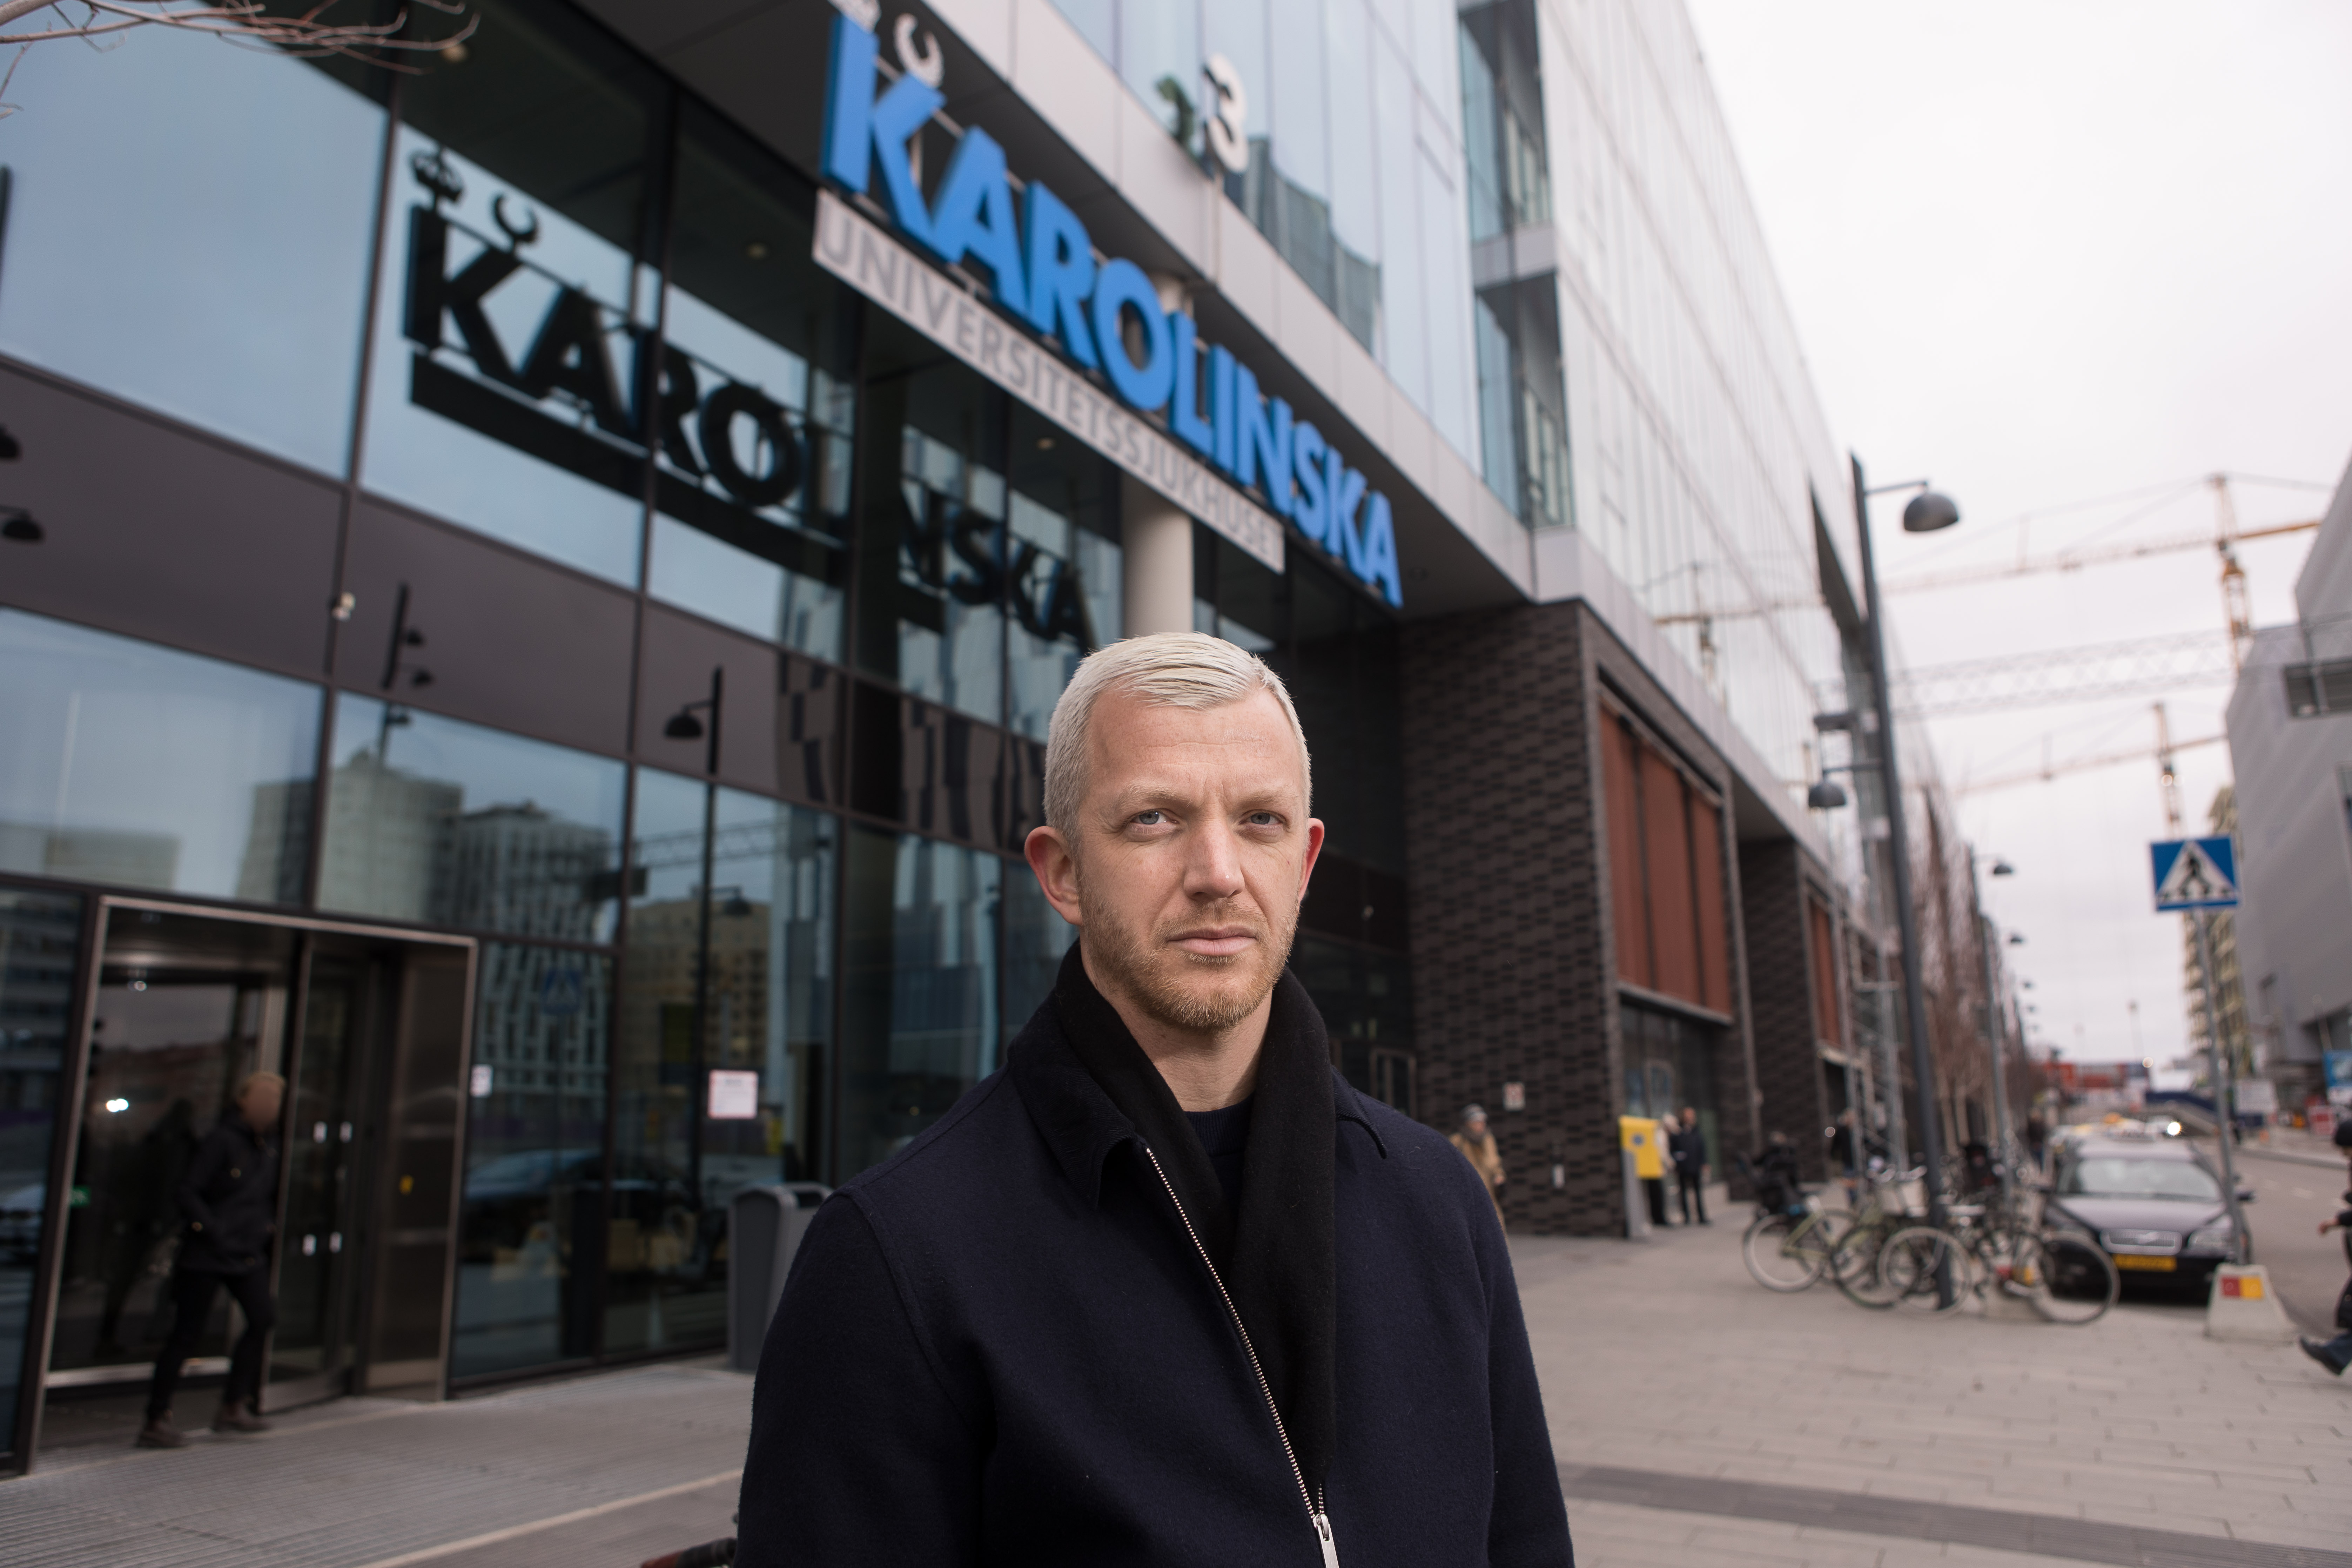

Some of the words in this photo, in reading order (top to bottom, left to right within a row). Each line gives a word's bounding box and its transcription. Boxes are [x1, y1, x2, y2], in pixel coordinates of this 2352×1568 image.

[1202, 53, 1249, 173] 3
[820, 12, 1402, 607] KAROLINSKA
[821, 199, 1282, 562] UNIVERSITETSSJUKHUSET
